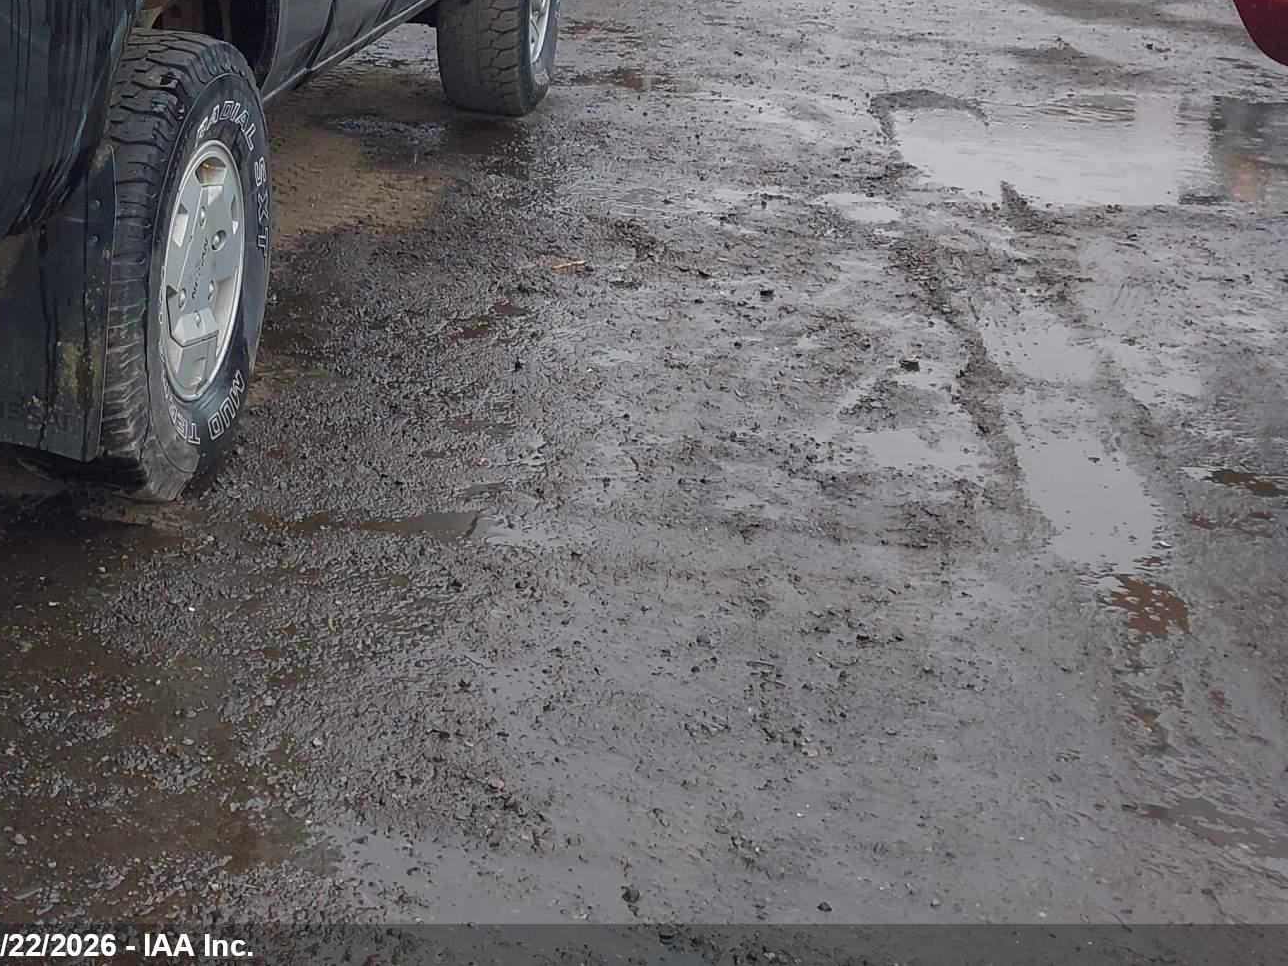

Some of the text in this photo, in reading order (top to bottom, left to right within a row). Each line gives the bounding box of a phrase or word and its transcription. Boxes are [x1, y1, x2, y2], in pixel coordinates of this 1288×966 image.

[195, 100, 270, 258] RADIAL SXT
[207, 369, 246, 441] MUD
